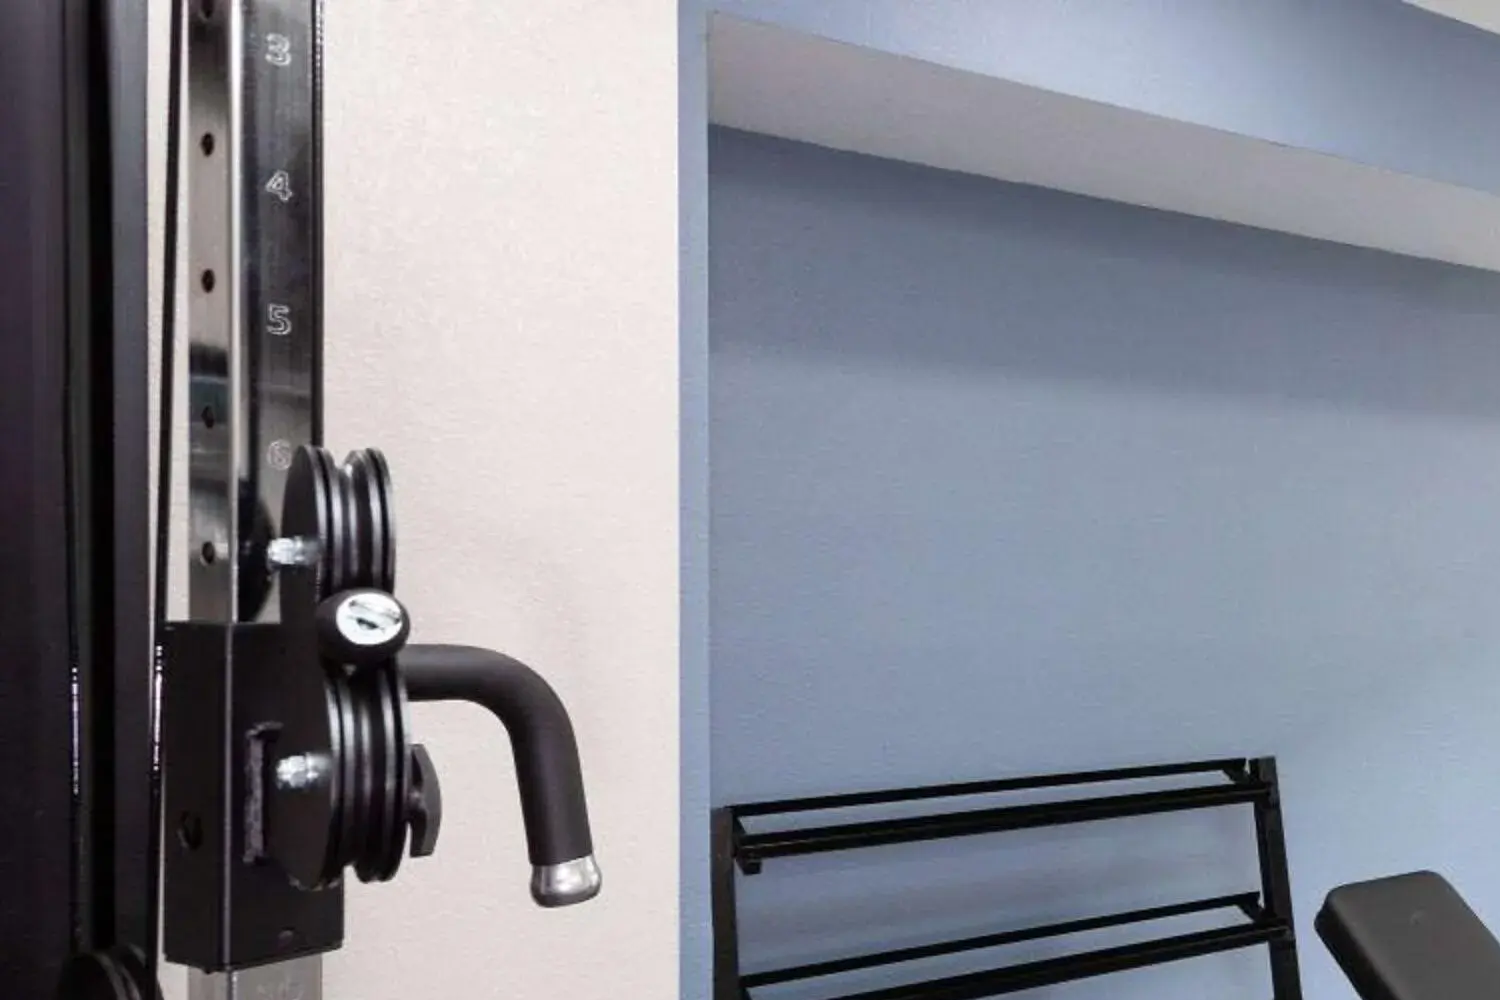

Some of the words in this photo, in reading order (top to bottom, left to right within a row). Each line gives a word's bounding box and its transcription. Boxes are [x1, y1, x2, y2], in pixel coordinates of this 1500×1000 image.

[265, 33, 291, 66] 3
[265, 169, 293, 201] 4
[266, 303, 292, 336] 5
[266, 439, 292, 471] 6
